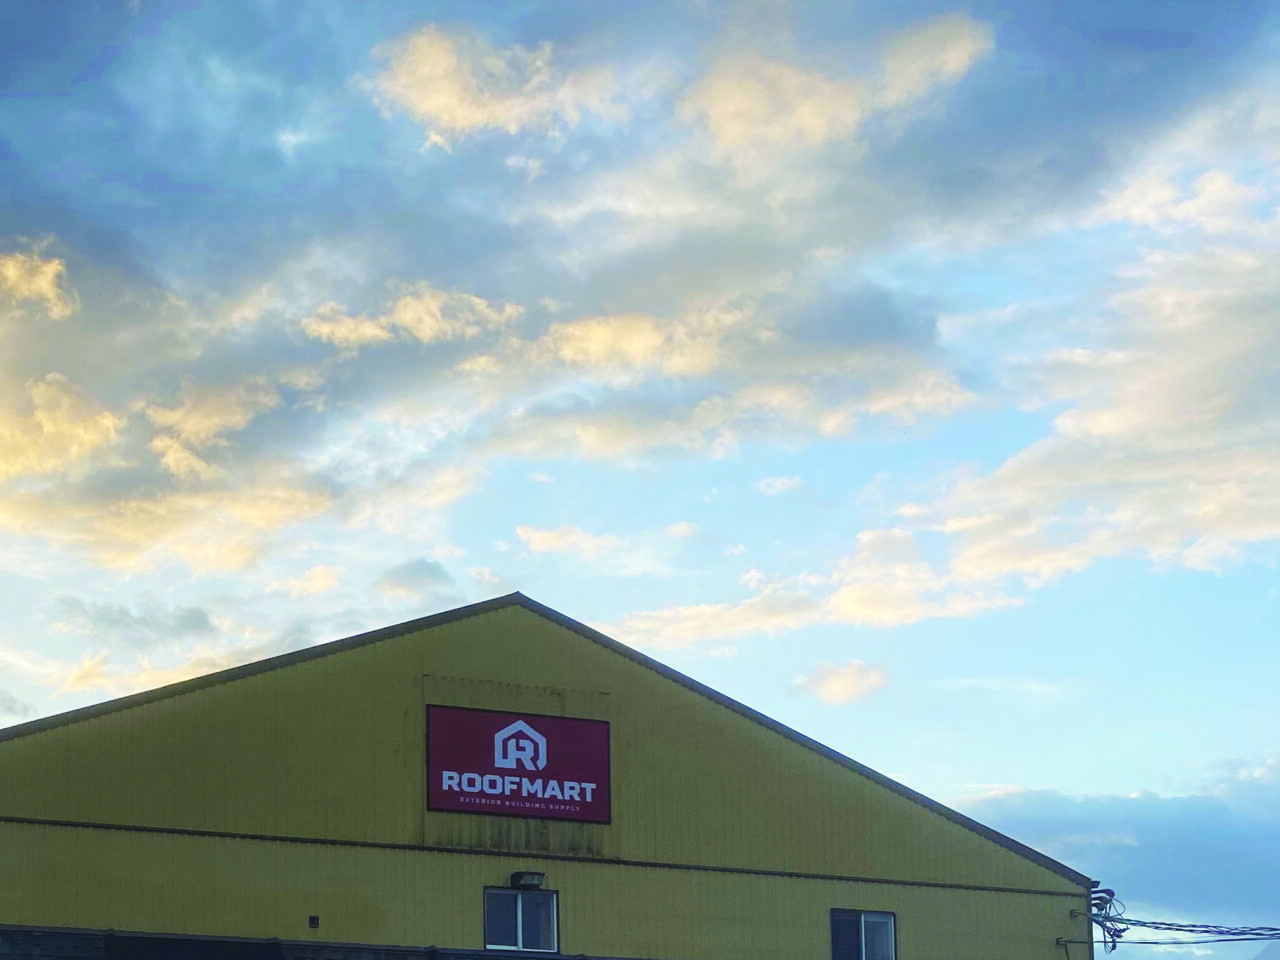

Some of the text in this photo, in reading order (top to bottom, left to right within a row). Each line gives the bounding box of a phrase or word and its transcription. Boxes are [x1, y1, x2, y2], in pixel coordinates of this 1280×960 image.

[441, 770, 597, 802] ROOFMART
[459, 796, 580, 813] EXTERIOR BUILDING SUPPLY
